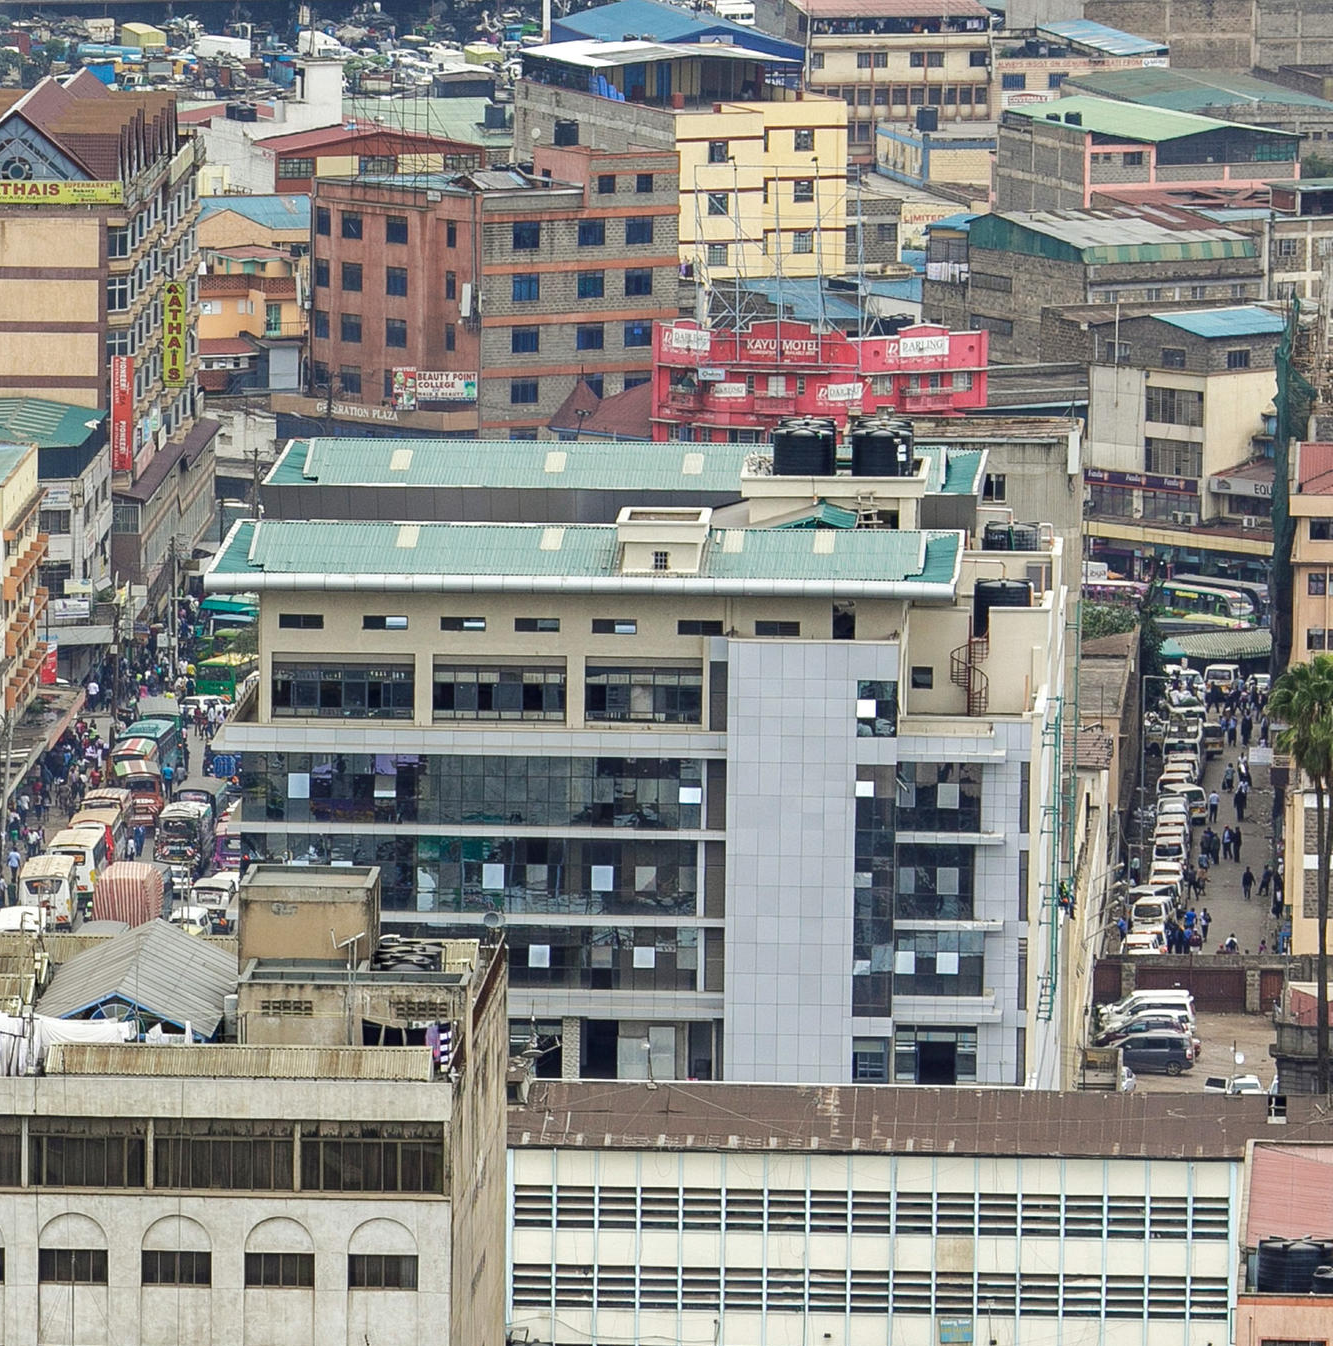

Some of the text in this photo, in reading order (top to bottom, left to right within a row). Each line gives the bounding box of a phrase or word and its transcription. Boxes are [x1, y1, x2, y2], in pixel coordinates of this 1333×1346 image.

[903, 214, 945, 224] LIMITED
[167, 295, 182, 381] ATHAIS
[746, 339, 819, 351] KAYU MOTEL
[901, 339, 944, 352] DARLING
[417, 372, 477, 381] BEAUTY POINT
[418, 381, 455, 389] COLLEGE
[372, 408, 399, 421] PLAZA
